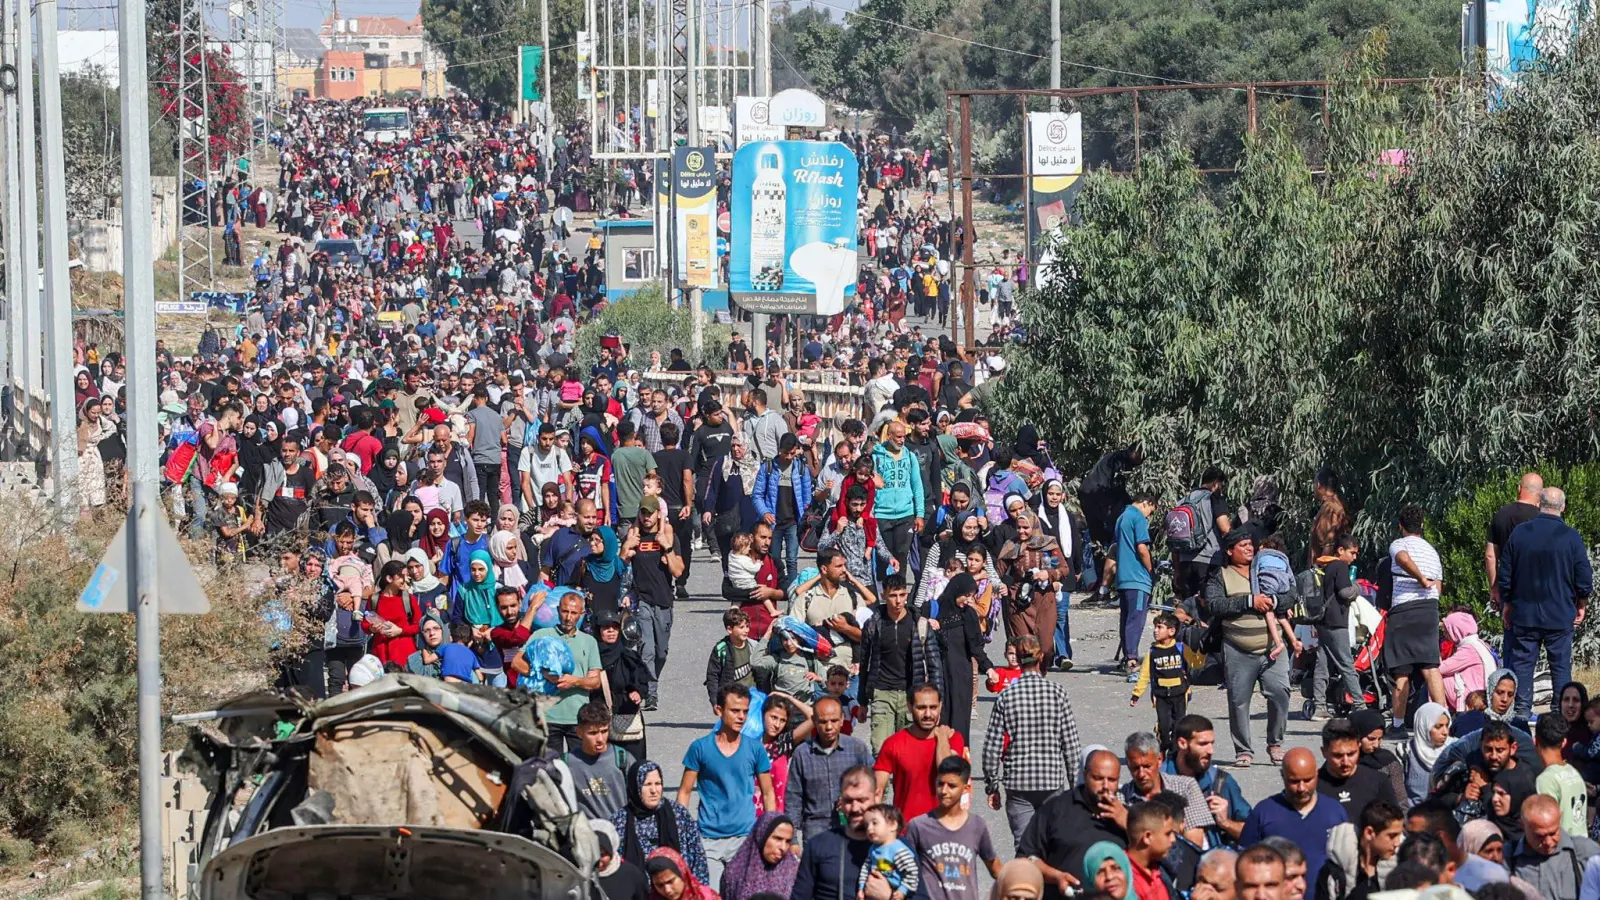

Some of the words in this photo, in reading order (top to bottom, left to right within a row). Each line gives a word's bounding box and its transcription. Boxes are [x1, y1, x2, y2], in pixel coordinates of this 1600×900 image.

[783, 107, 817, 123] روزان
[801, 152, 844, 168] رفلاش
[793, 168, 844, 188] Rflash
[184, 304, 204, 312] شرطة
[890, 469, 904, 480] 36
